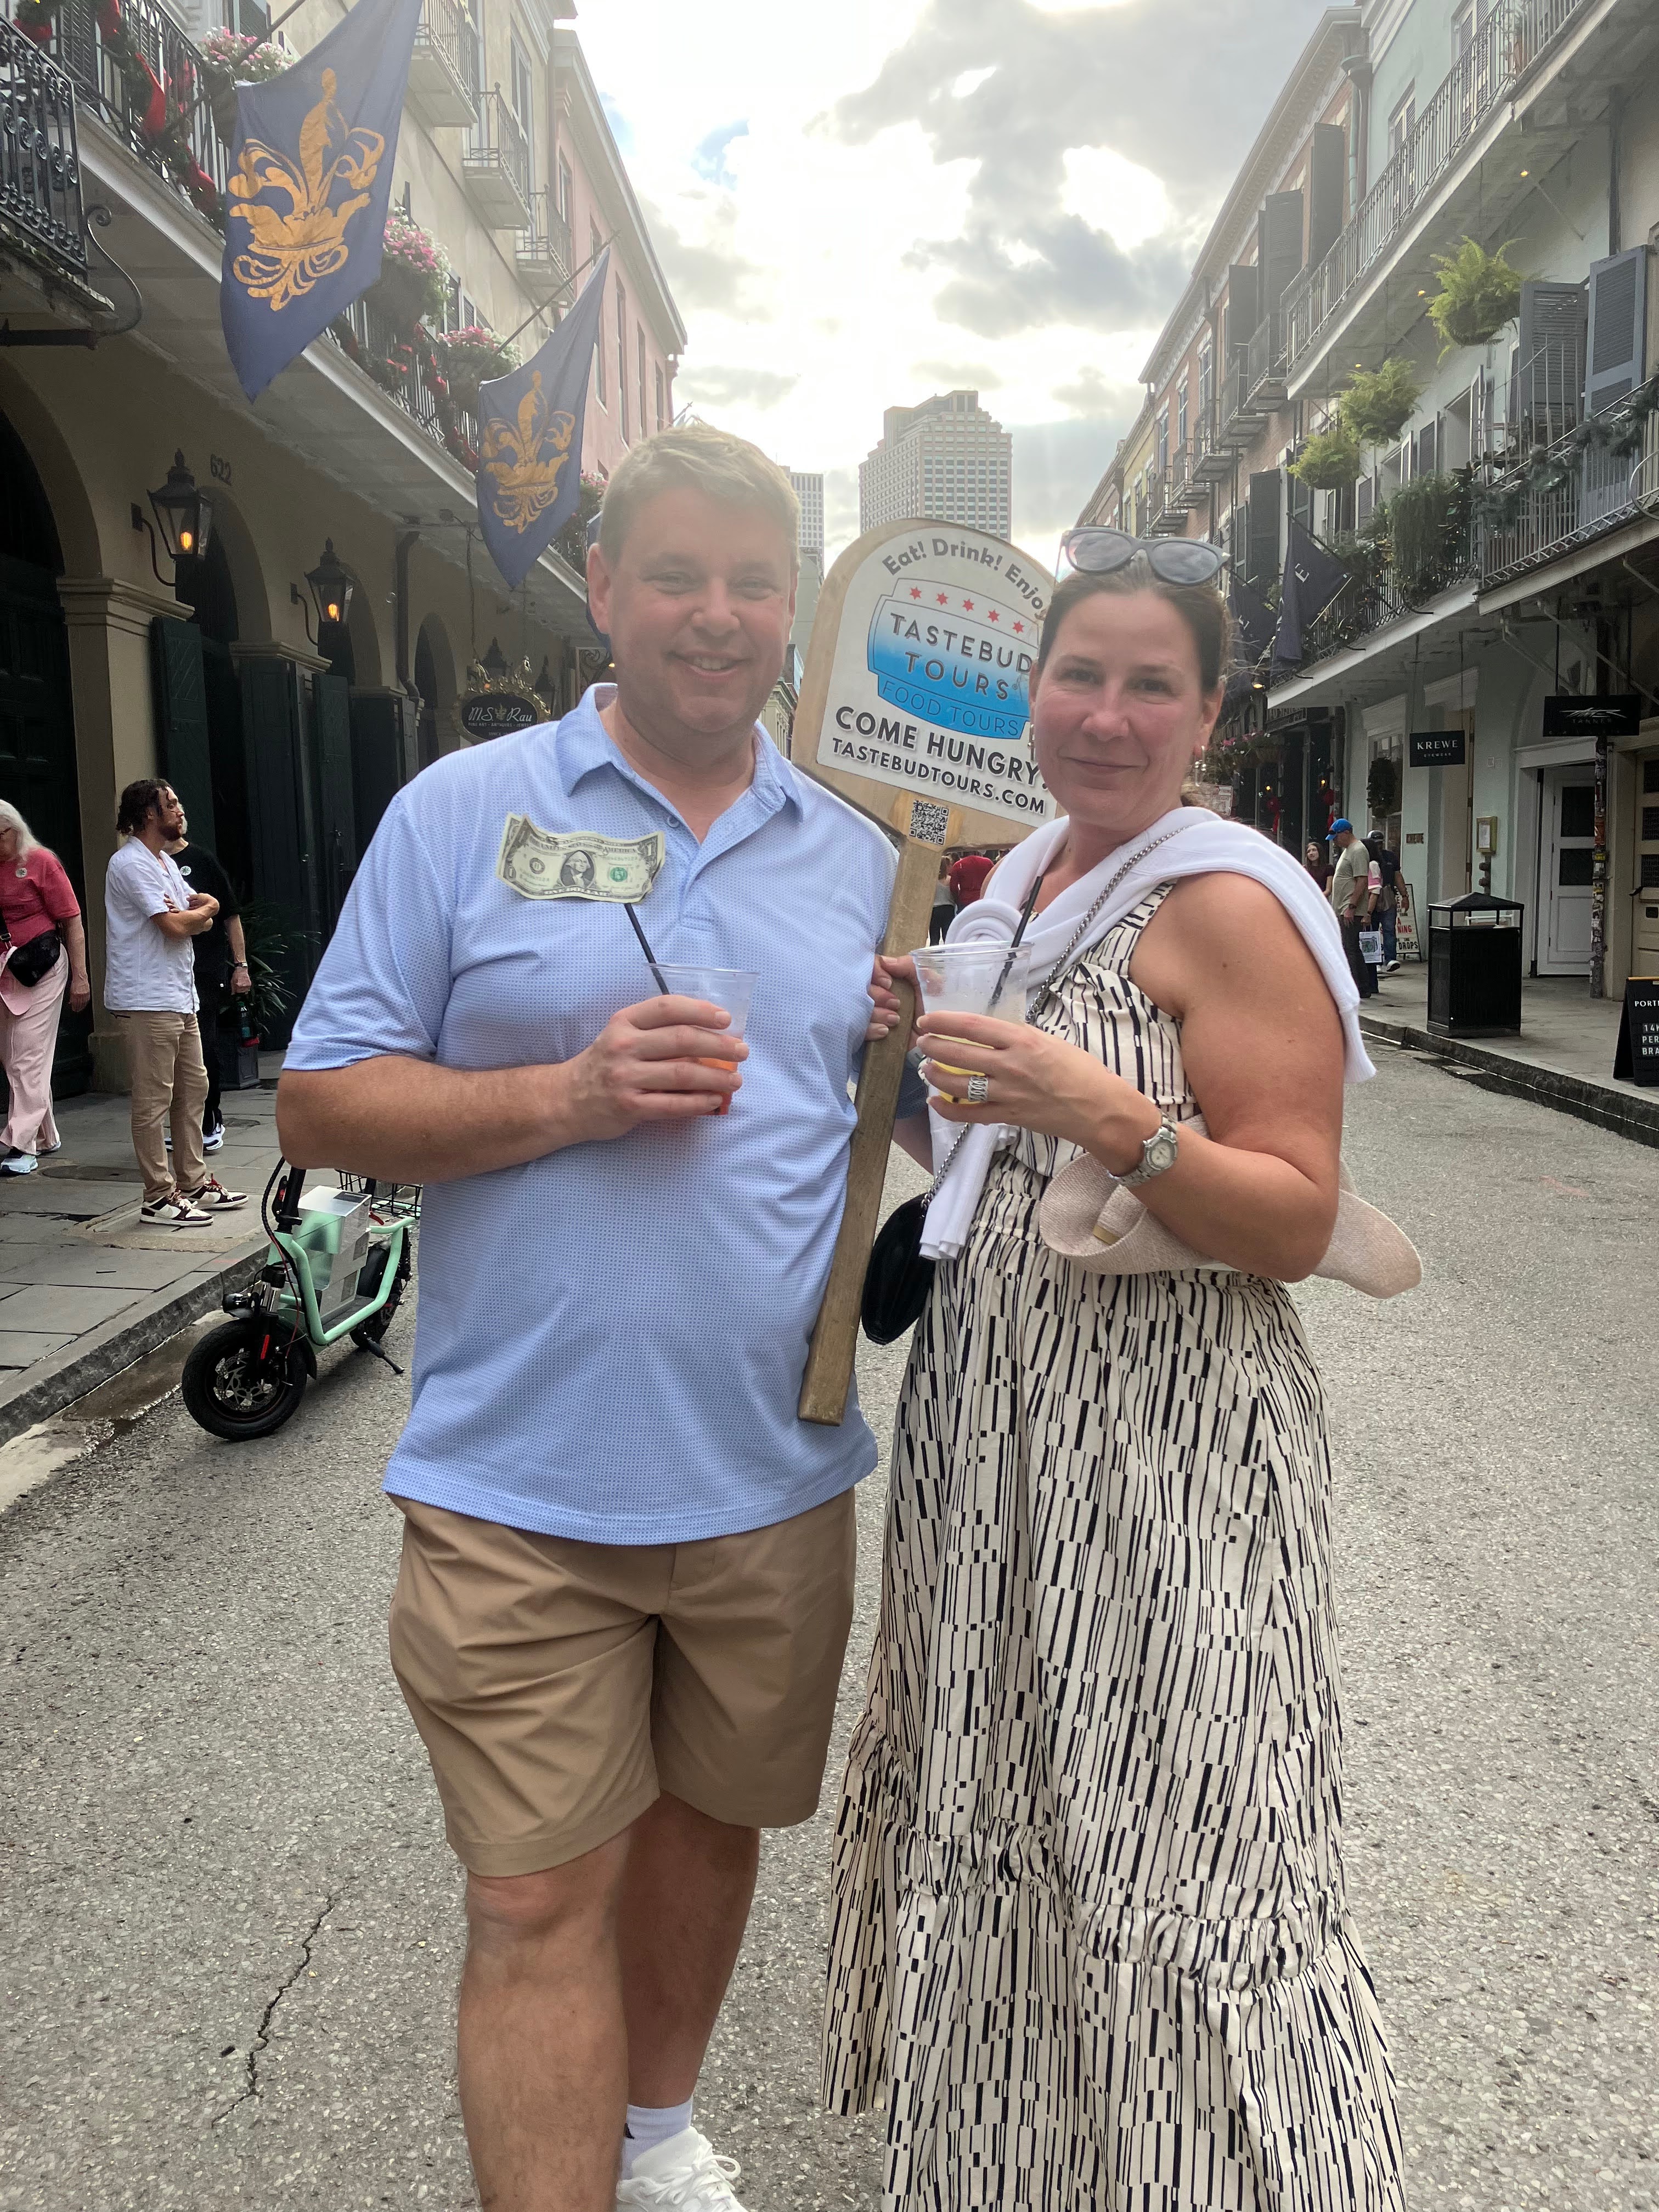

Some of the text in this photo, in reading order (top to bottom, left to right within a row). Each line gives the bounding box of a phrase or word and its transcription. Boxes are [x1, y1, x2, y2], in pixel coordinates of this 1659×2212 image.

[211, 453, 232, 486] 622
[882, 540, 927, 575] Eat!
[932, 538, 1003, 571] Drink!
[890, 612, 1032, 674] TASTEBUD
[506, 707, 532, 722] Rau
[882, 680, 1019, 737] FOOD TOURS
[836, 706, 1048, 790] COME HUNGRY
[1417, 739, 1459, 751] KREWE
[832, 737, 1045, 815] TASTEBUDTOURS.COM
[1398, 941, 1418, 950] DROPS
[1642, 1035, 1659, 1043] PER
